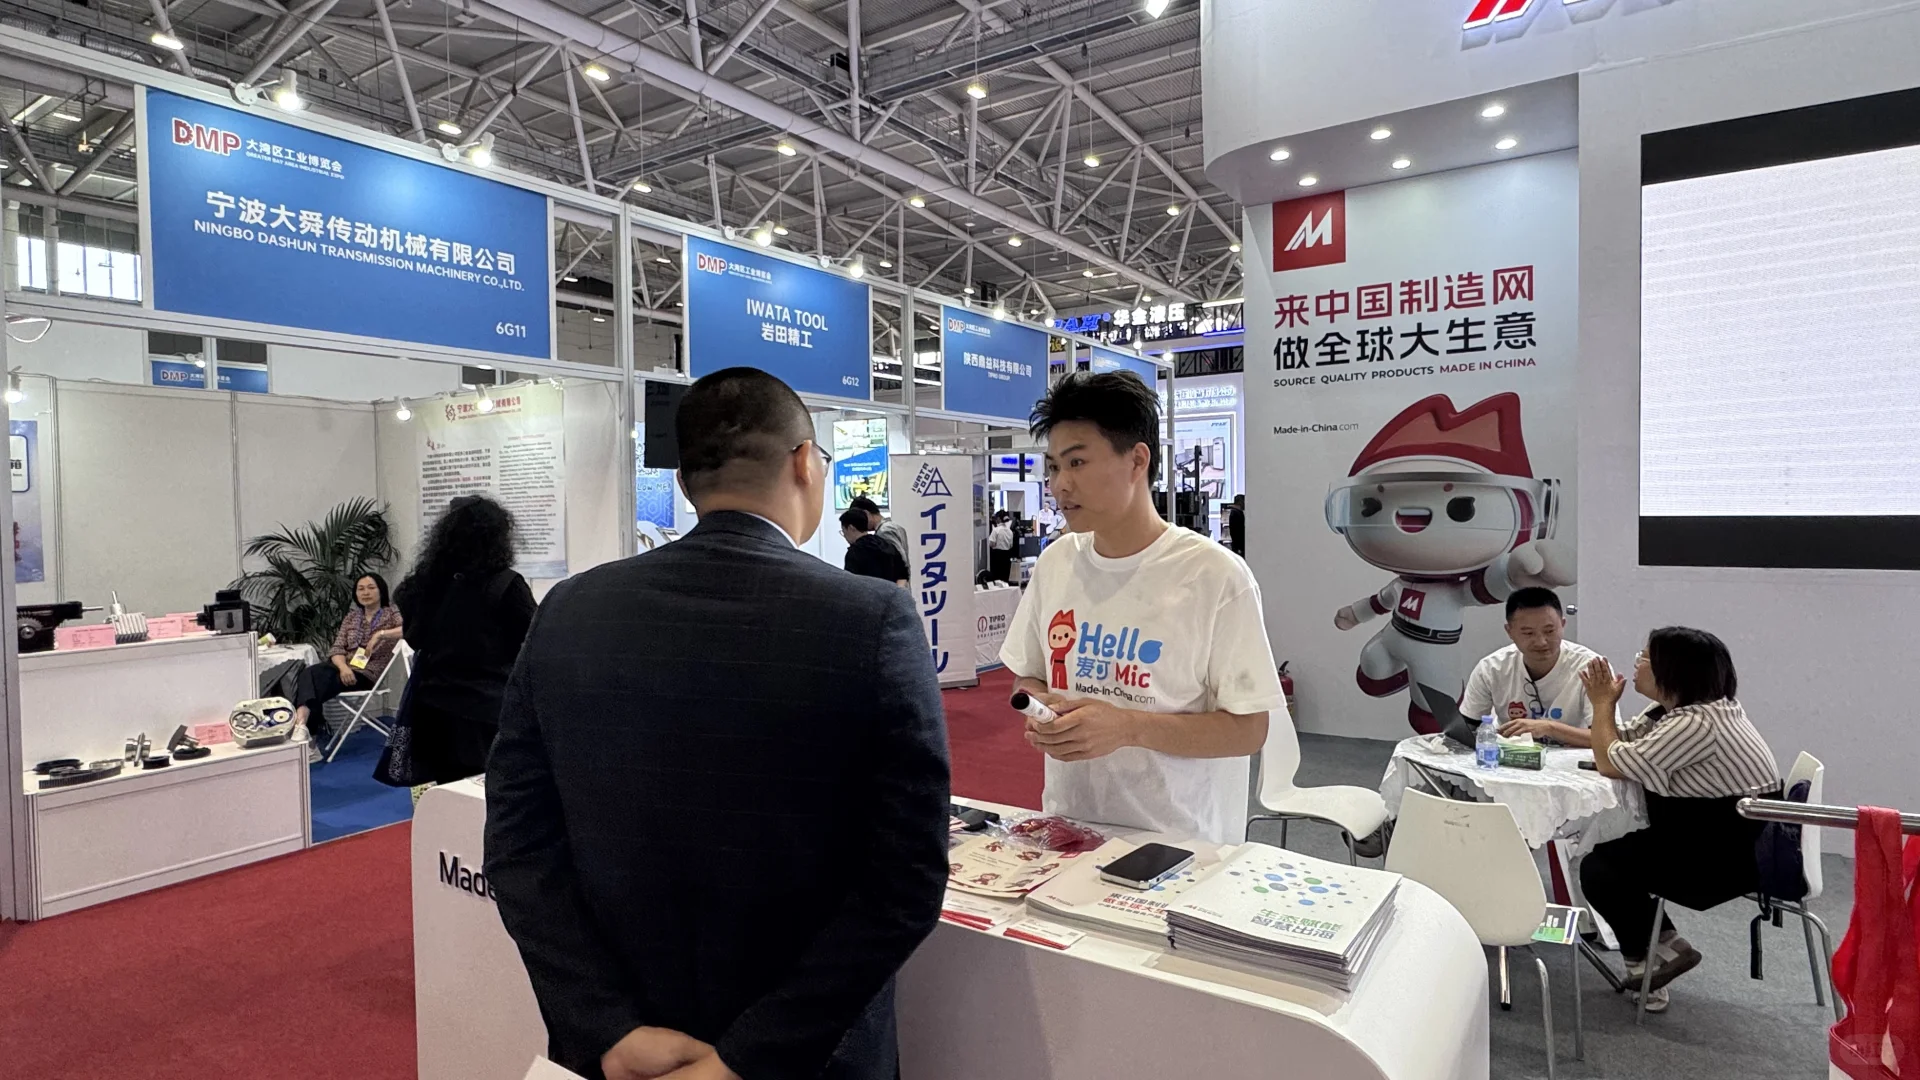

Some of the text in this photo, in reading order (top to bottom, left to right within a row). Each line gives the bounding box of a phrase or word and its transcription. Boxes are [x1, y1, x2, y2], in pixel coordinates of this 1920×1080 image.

[172, 117, 241, 156] DMP
[246, 139, 343, 172] 大湾区工业博览会
[206, 191, 516, 275] 宁波大舜传动机械有限公司
[194, 219, 525, 291] NINGBO DASHUN TRANSMISSION MACHINERY CO.,LTD.
[697, 252, 727, 275] DMP
[1274, 265, 1534, 329] 来中国制造网
[746, 298, 829, 331] IWATA TOOL
[948, 317, 966, 334] DMP
[495, 321, 527, 338] 6G11
[761, 322, 813, 348] 岩田精工
[1273, 311, 1537, 371] 做全球大生意
[161, 369, 188, 382] DMP
[842, 375, 860, 387] 6G12
[1273, 358, 1537, 387] SOURCE QUALITY PRODUCTS MADE IN CHINA
[911, 462, 929, 492] IWATA
[916, 467, 935, 494] TOOL
[920, 503, 949, 673] イワタツール
[1078, 621, 1163, 664] Hello
[1075, 656, 1111, 680] 麦可
[1115, 662, 1151, 688] Mic
[1250, 915, 1337, 940] 智慧出海
[1256, 908, 1344, 931] 生态赋能
